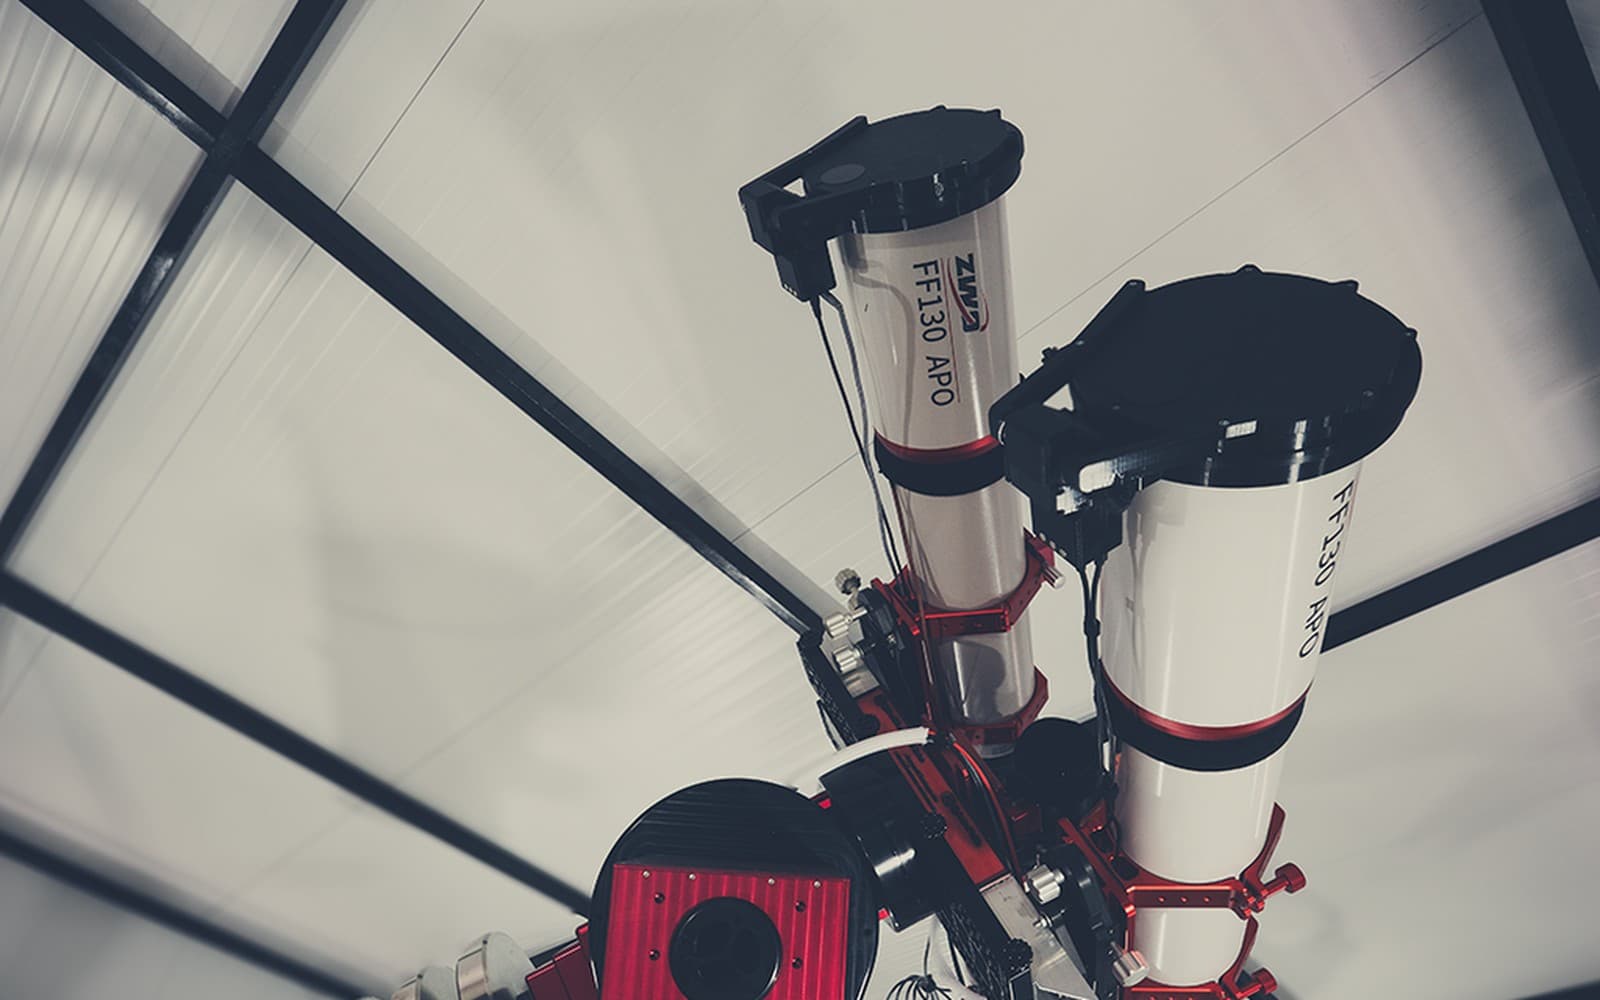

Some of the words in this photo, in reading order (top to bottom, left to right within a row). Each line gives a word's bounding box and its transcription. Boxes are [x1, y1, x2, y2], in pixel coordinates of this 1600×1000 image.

[913, 259, 947, 342] FF130
[926, 355, 955, 406] APO
[1314, 479, 1354, 586] FF130
[1299, 596, 1328, 658] APO
